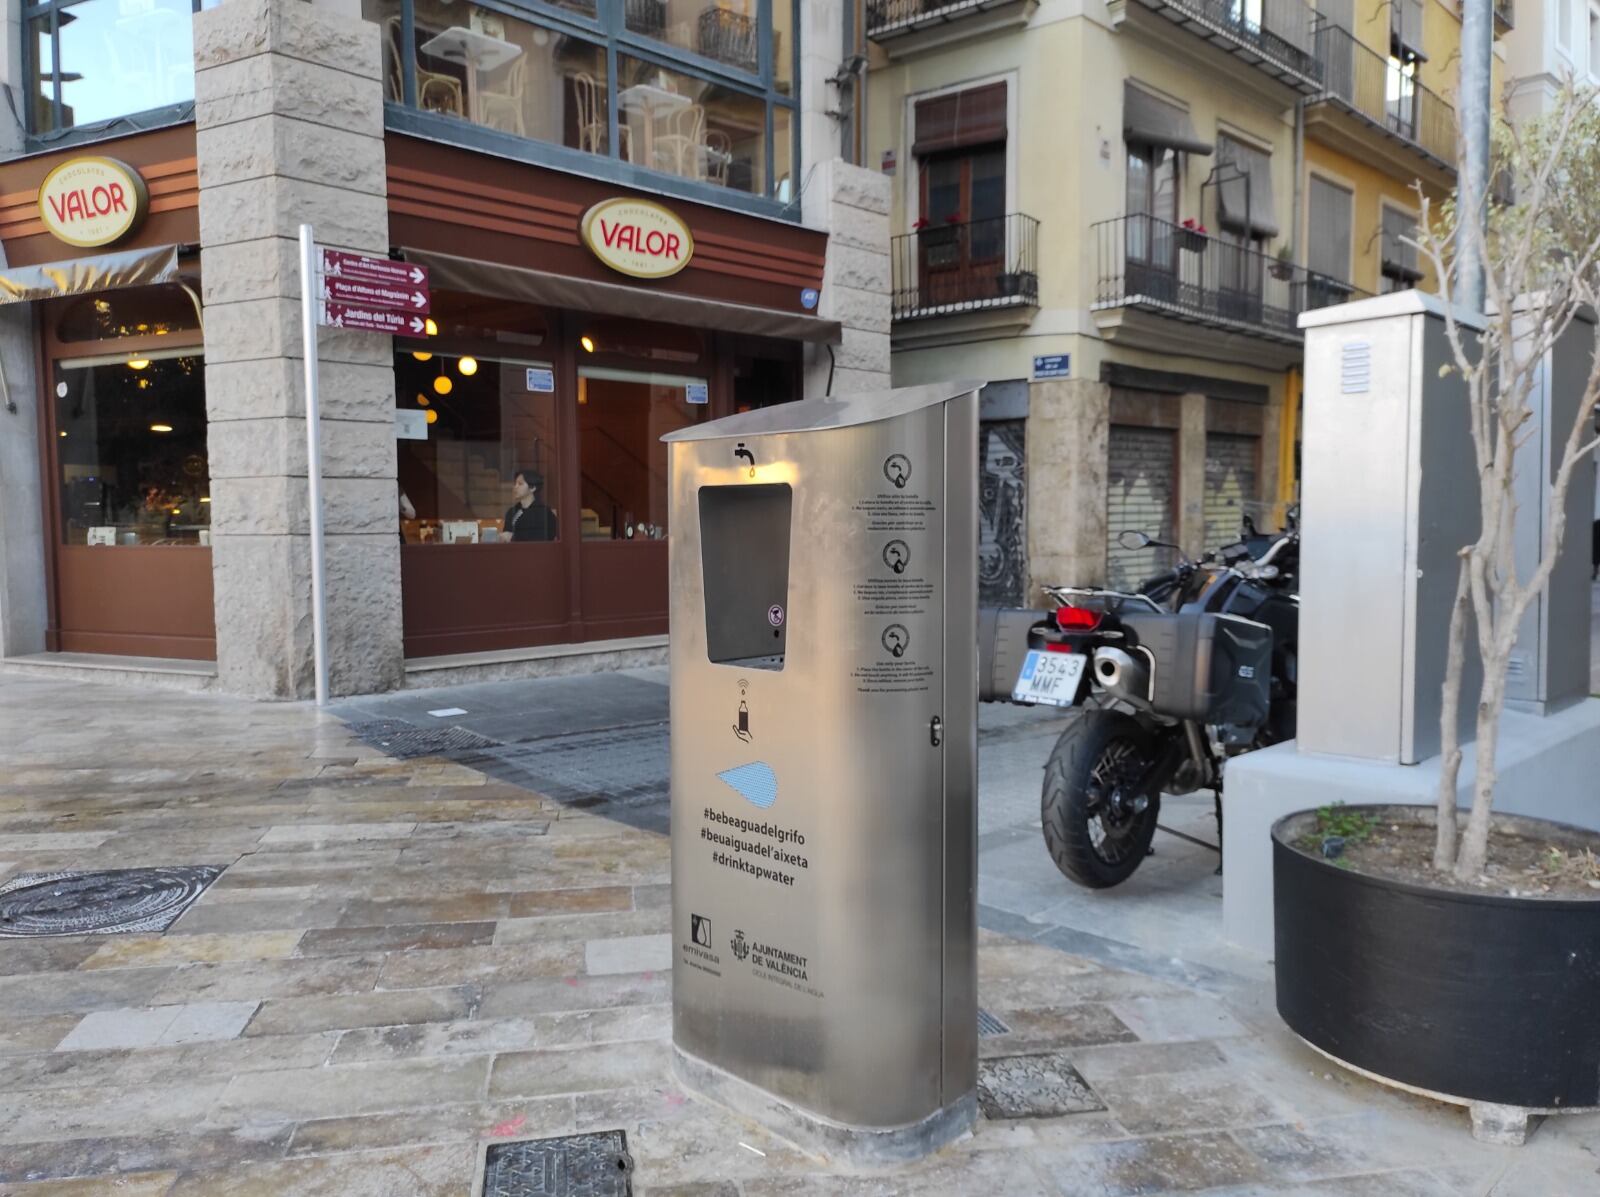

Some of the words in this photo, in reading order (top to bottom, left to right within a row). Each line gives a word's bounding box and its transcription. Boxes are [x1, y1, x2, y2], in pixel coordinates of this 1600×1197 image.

[48, 182, 128, 223] VALOR
[600, 218, 680, 260] VALOR
[344, 308, 372, 320] Jardins
[373, 312, 385, 322] del
[1030, 674, 1064, 694] MMF
[703, 807, 805, 845] #bebeaguadelgrifo
[712, 851, 795, 886] #drinktapwater
[683, 944, 720, 965] emivasa
[752, 942, 808, 967] AJUNTAMENT
[752, 954, 763, 966] DE
